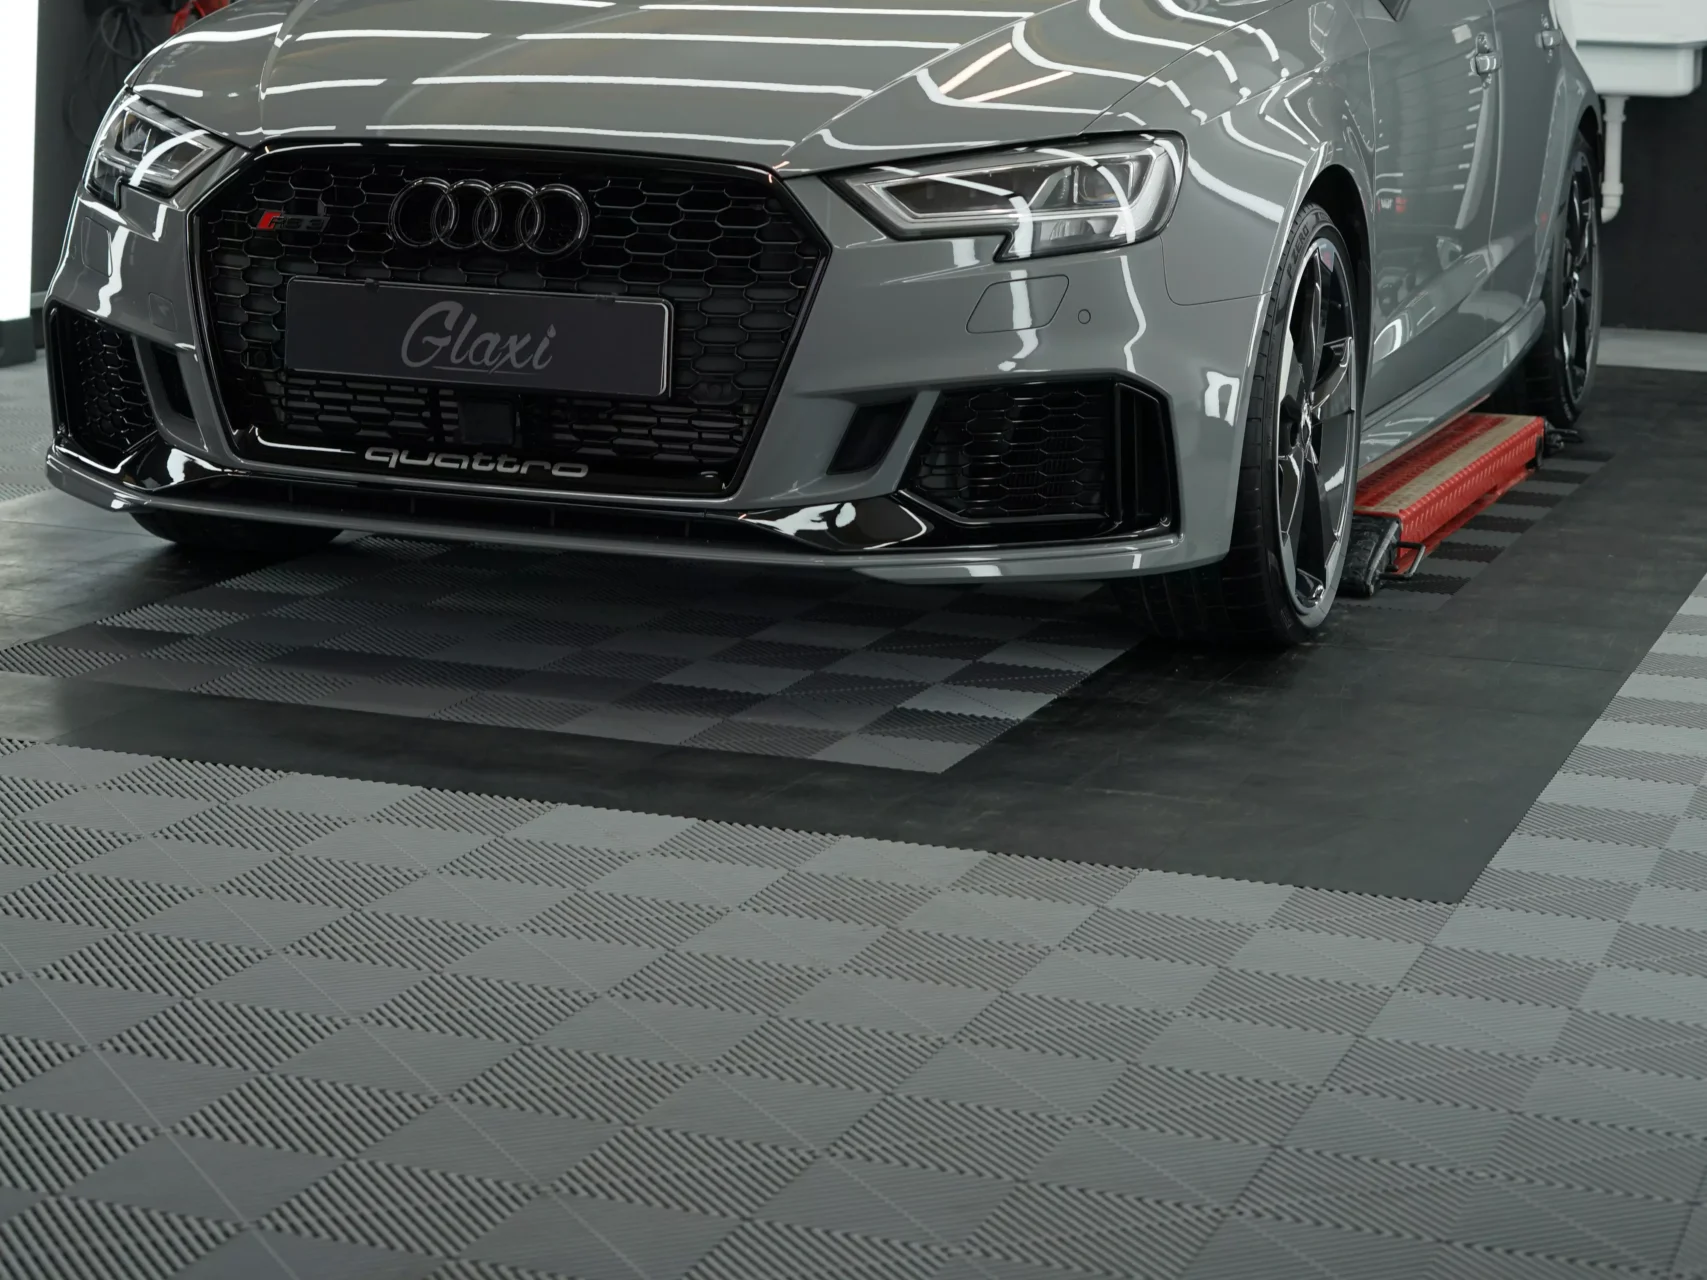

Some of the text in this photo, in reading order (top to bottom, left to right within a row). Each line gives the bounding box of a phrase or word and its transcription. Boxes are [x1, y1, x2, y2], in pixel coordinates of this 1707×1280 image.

[1292, 225, 1309, 264] ZERO
[401, 300, 557, 374] Glaxi
[364, 446, 589, 478] quattro
